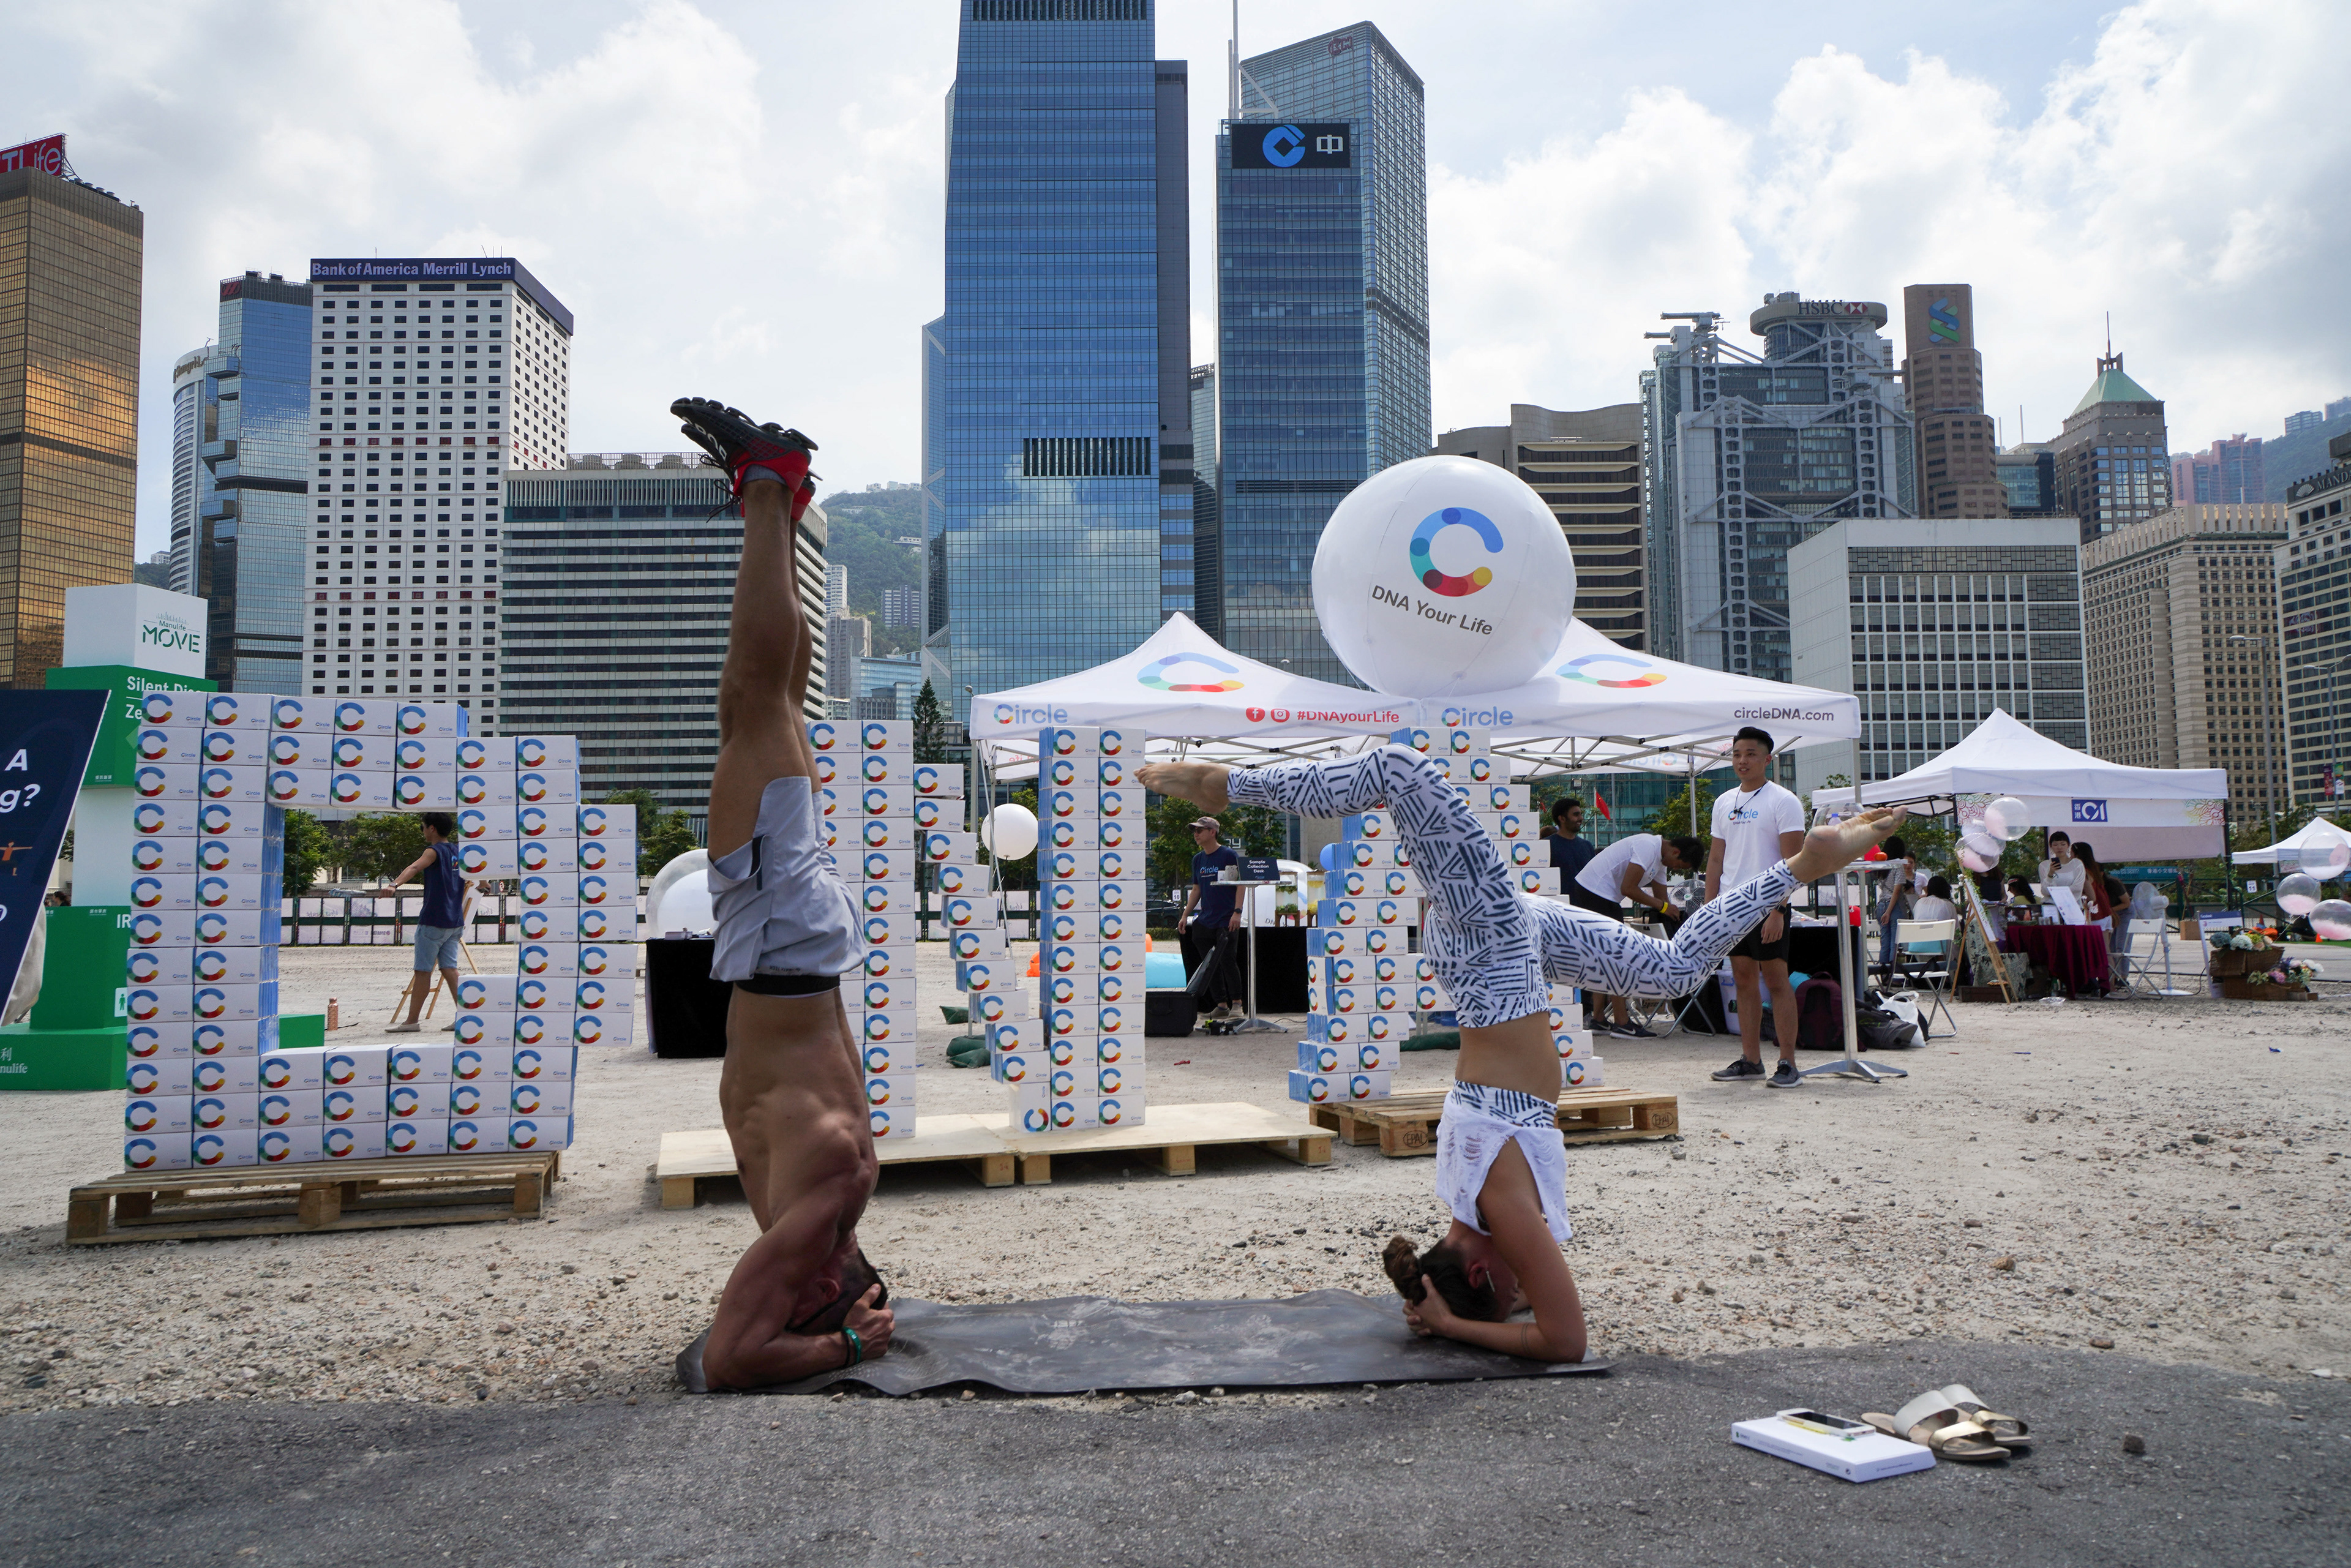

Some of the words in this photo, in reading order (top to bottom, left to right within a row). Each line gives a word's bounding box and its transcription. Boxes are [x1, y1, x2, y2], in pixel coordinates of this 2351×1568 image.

[1316, 134, 1344, 154] 中
[312, 263, 346, 276] Bank
[348, 262, 361, 275] of
[363, 262, 418, 275] America
[423, 262, 467, 275] Merrill
[472, 262, 511, 277] Lynch
[1797, 302, 1843, 315] HSBC
[1371, 585, 1409, 612] DNA
[1416, 599, 1457, 626] Your
[1459, 613, 1493, 636] Life
[159, 620, 187, 631] Manulife
[142, 625, 201, 653] MOVE
[127, 675, 169, 691] Silent
[994, 703, 1068, 724] Circle
[1297, 710, 1400, 724] #DNAyourLife
[1441, 706, 1513, 727] Circle
[1734, 706, 1834, 722] circleDNA.com
[4, 748, 28, 771] A
[1199, 865, 1219, 874] Circle
[1406, 1133, 1424, 1145] EPAL
